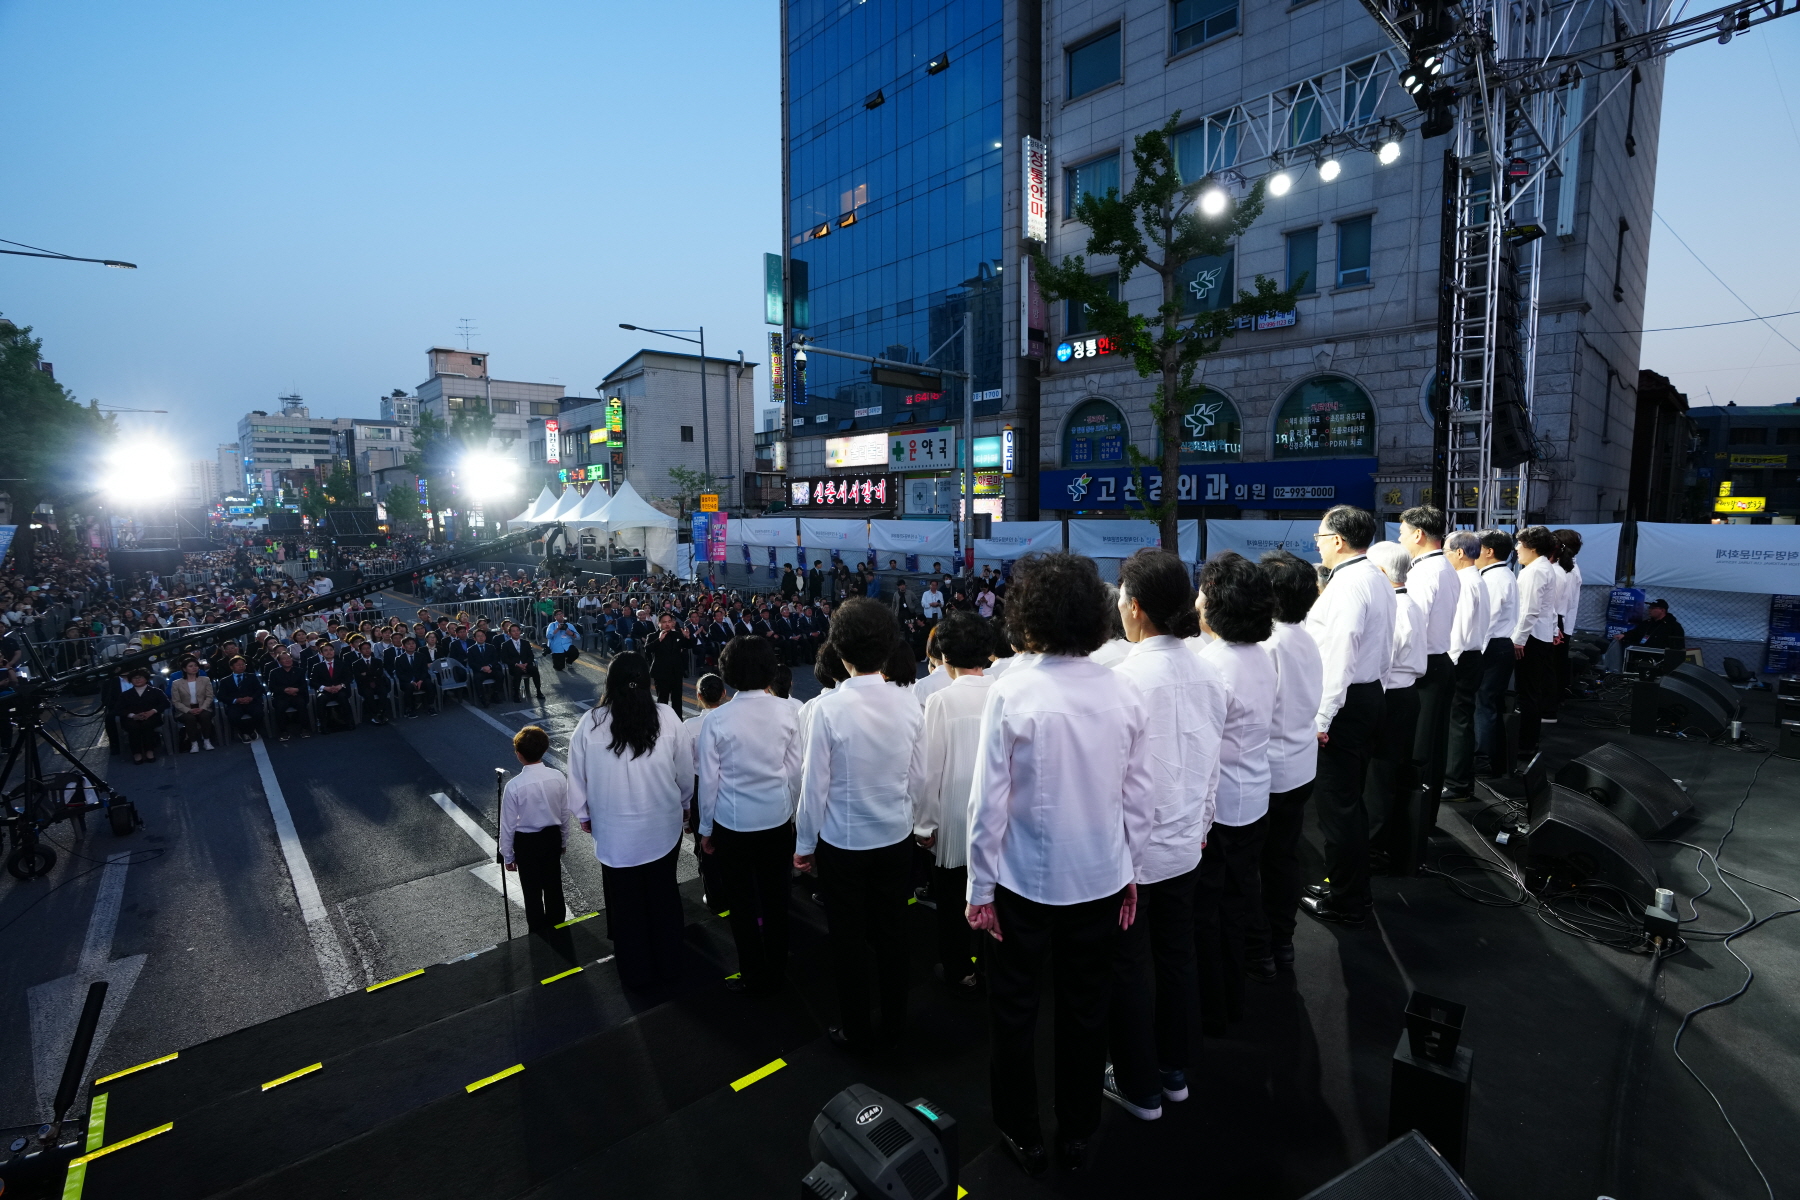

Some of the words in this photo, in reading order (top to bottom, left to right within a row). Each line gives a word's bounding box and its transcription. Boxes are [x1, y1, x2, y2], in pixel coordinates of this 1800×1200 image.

[1031, 150, 1045, 218] 정통안마
[773, 356, 783, 386] 아로마
[985, 390, 1000, 399] 1700
[1346, 412, 1366, 421] 유도치료
[1350, 438, 1363, 447] 치료
[978, 475, 1002, 486] 아로마
[813, 478, 888, 504] 신촌서서갈비
[1235, 483, 1266, 500] 의원
[1274, 487, 1332, 499] 02-993-0000
[859, 1105, 880, 1123] BEAM
